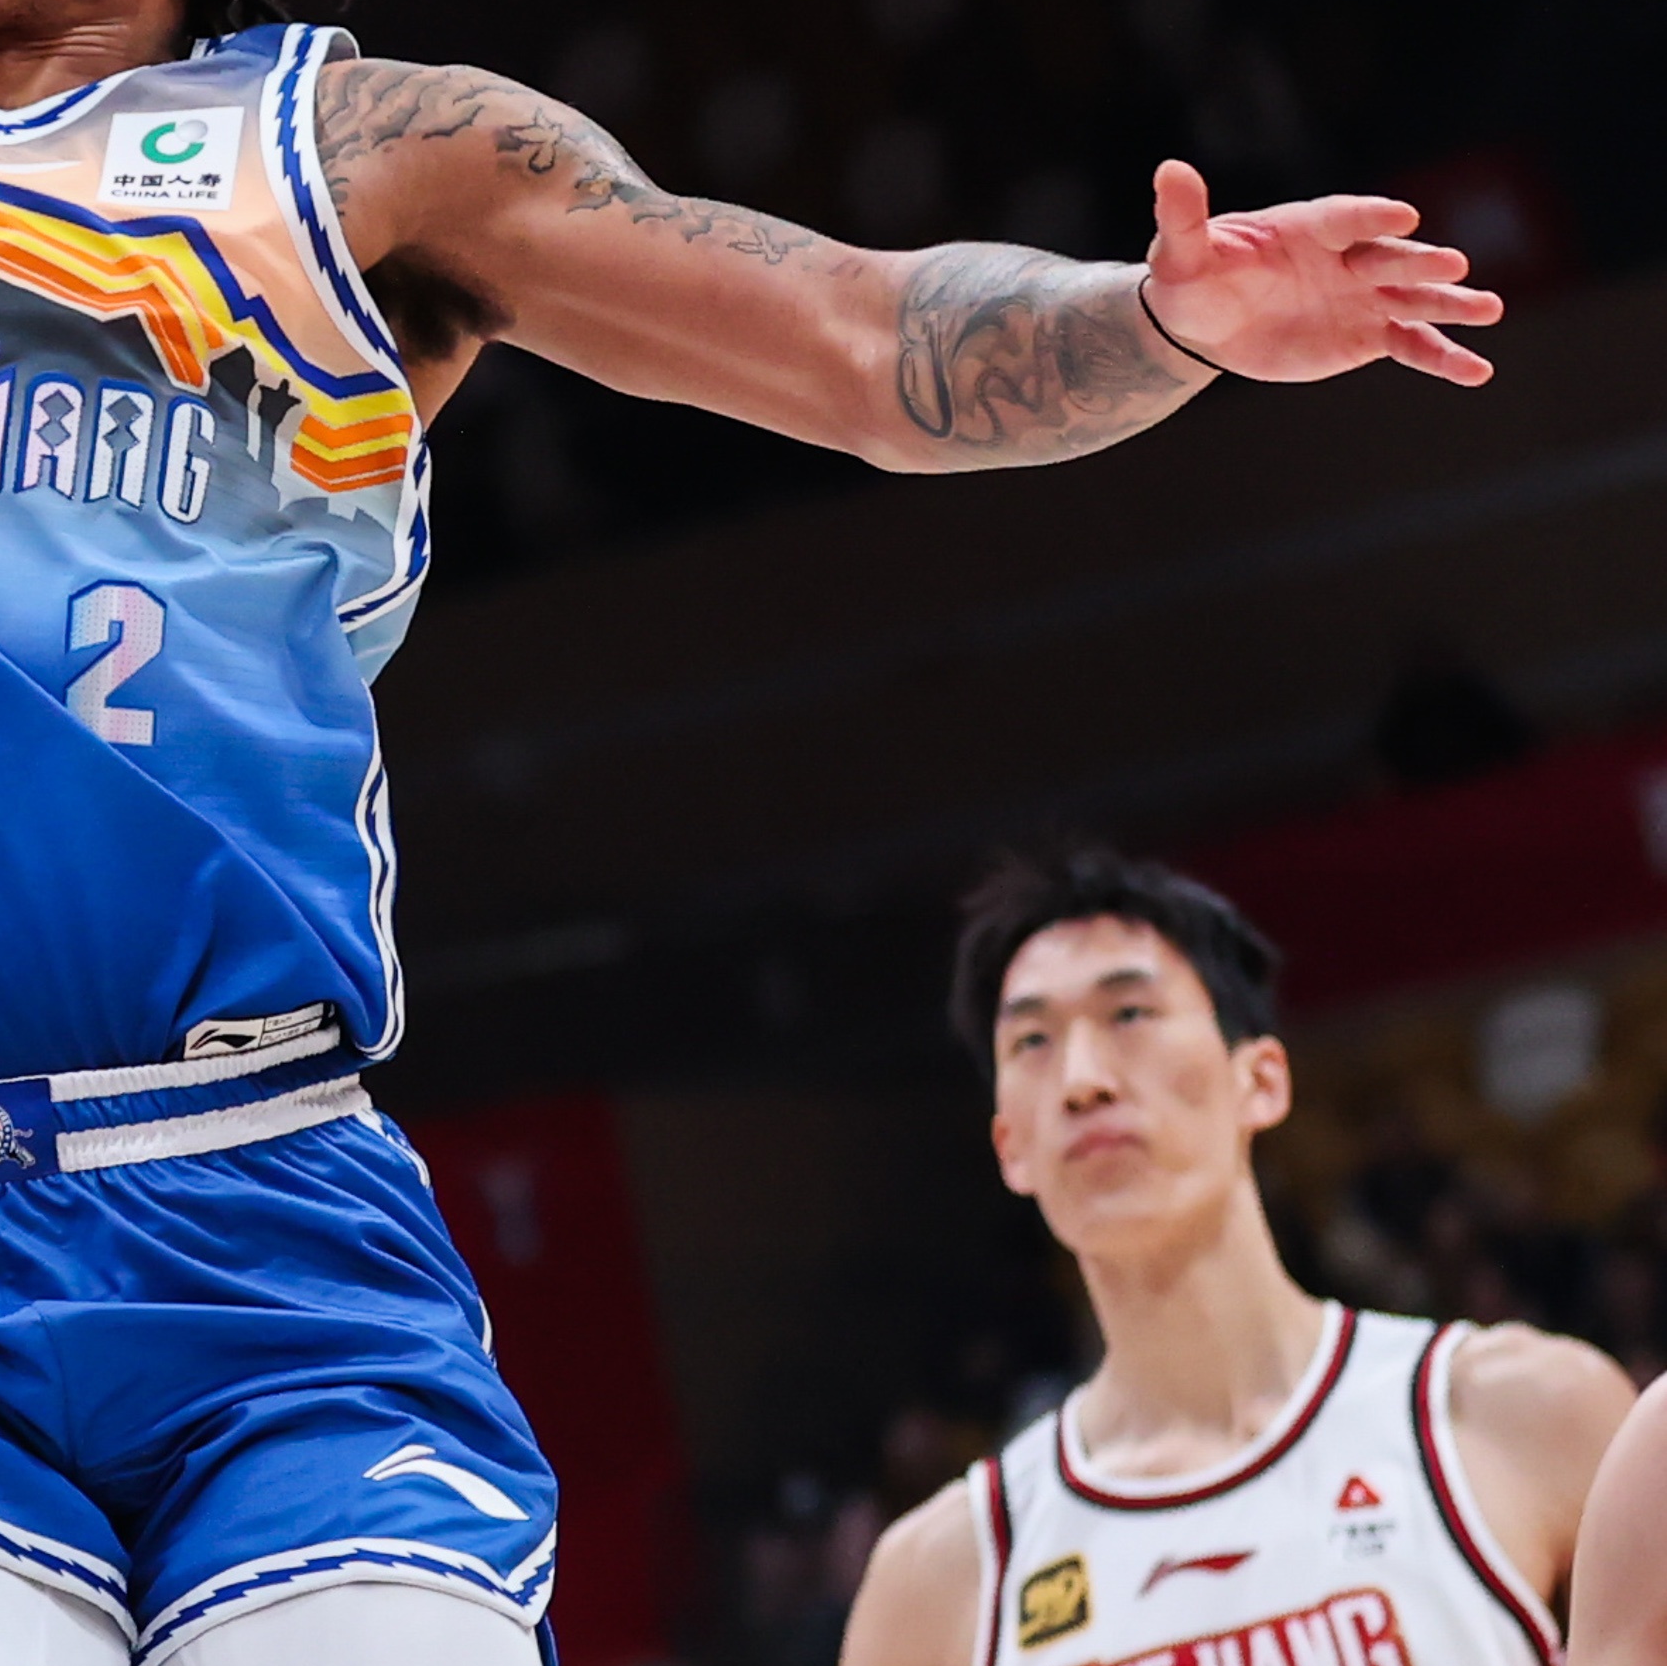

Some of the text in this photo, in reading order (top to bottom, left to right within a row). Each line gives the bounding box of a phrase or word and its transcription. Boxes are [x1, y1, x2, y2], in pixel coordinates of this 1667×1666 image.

[113, 172, 222, 188] 中国人寿
[111, 189, 218, 200] CHINA LIFE
[65, 579, 167, 747] 2
